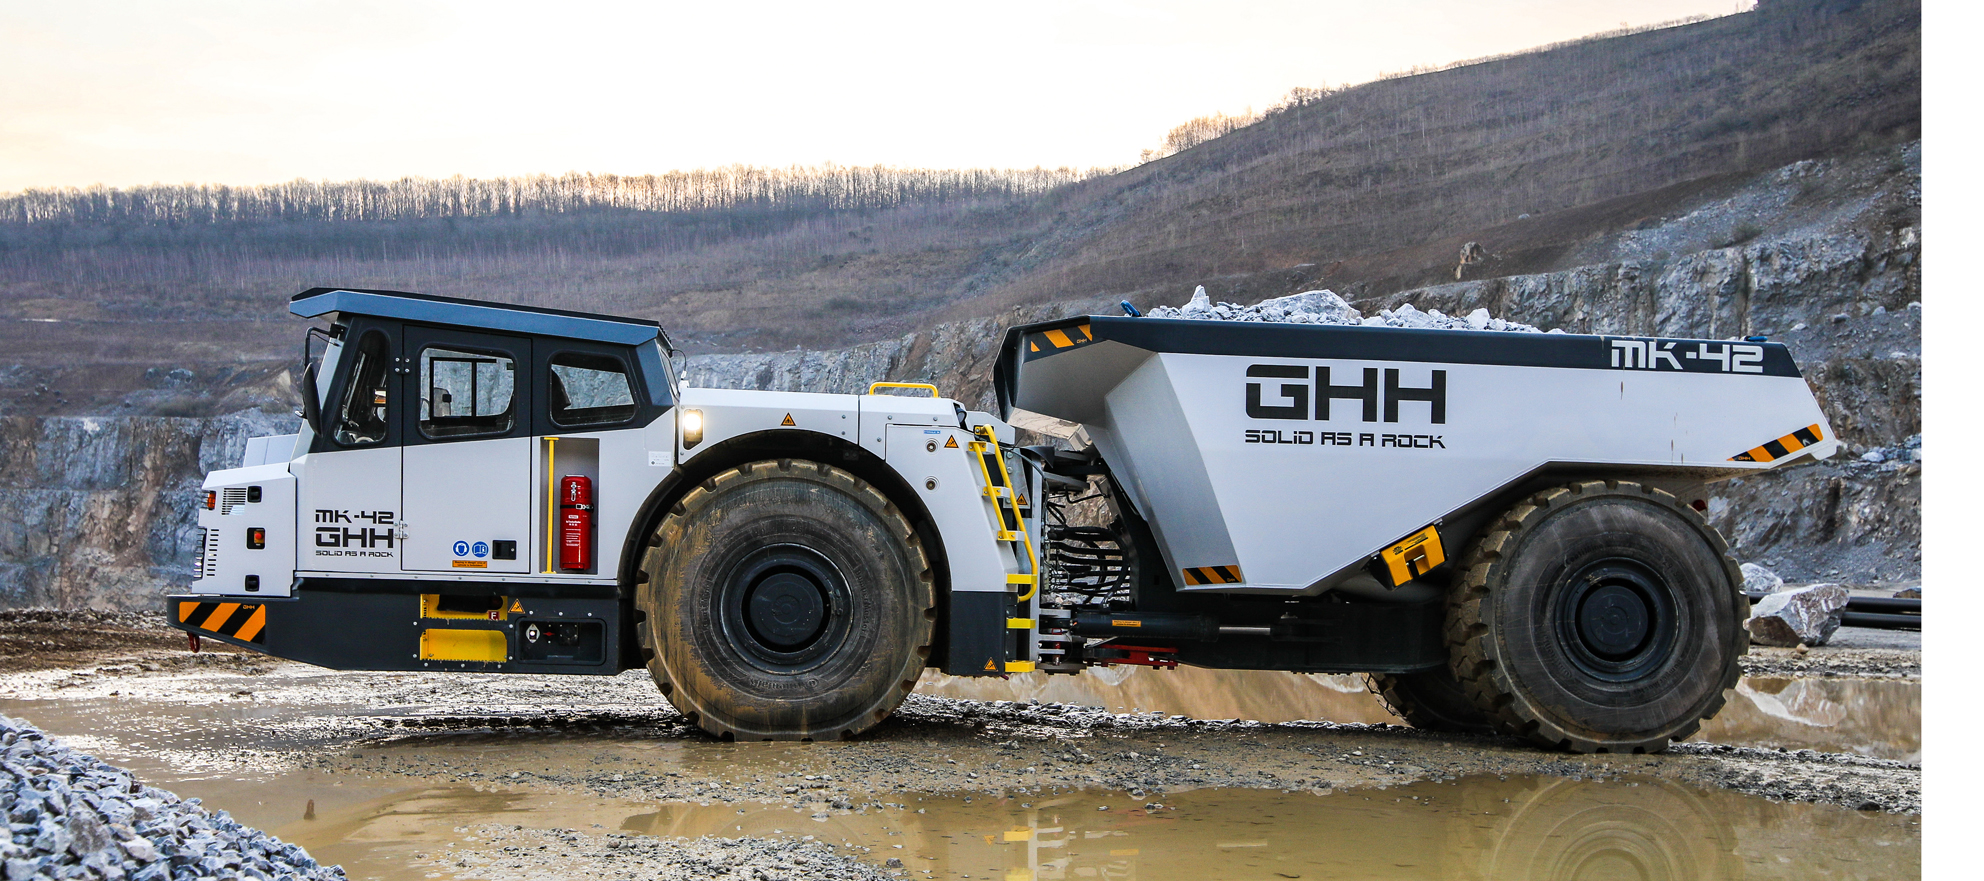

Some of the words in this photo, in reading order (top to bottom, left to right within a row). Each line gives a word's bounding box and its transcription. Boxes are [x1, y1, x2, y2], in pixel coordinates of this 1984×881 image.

[1611, 340, 1764, 373] MK-42
[1245, 363, 1447, 425] GHH
[1320, 431, 1353, 446] AS
[1359, 432, 1375, 447] A
[1381, 433, 1447, 449] ROCK
[315, 509, 395, 525] MK-42
[315, 526, 394, 549] GHH
